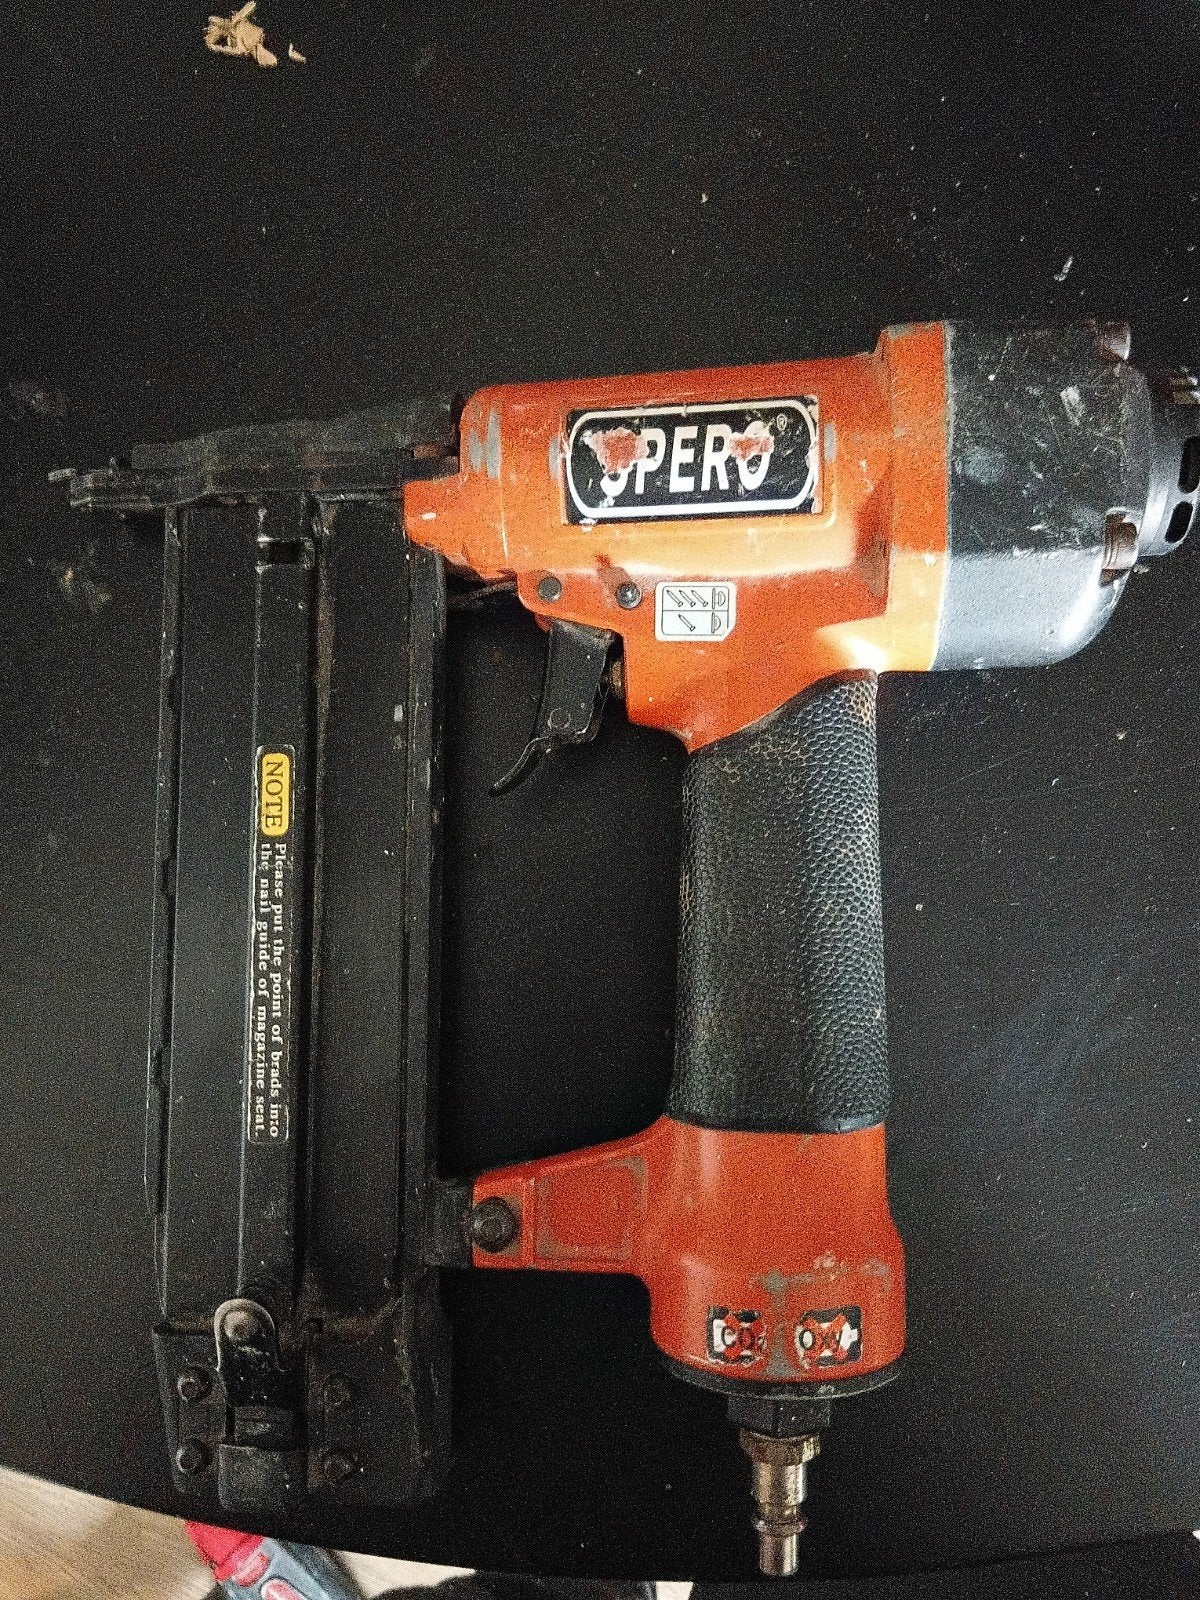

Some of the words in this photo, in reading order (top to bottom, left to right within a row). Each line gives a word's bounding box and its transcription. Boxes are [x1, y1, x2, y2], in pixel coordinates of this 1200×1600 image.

[599, 420, 772, 498] PERO
[265, 760, 284, 829] NOTE
[260, 842, 273, 871] the
[274, 842, 287, 899] Please
[260, 878, 272, 915] nail
[271, 904, 285, 931] put
[257, 921, 271, 971] guide
[273, 939, 285, 966] the
[258, 977, 270, 997] of
[270, 972, 285, 1019] point
[255, 1006, 269, 1090] magazine
[271, 1024, 283, 1044] of
[270, 1051, 283, 1098] brads
